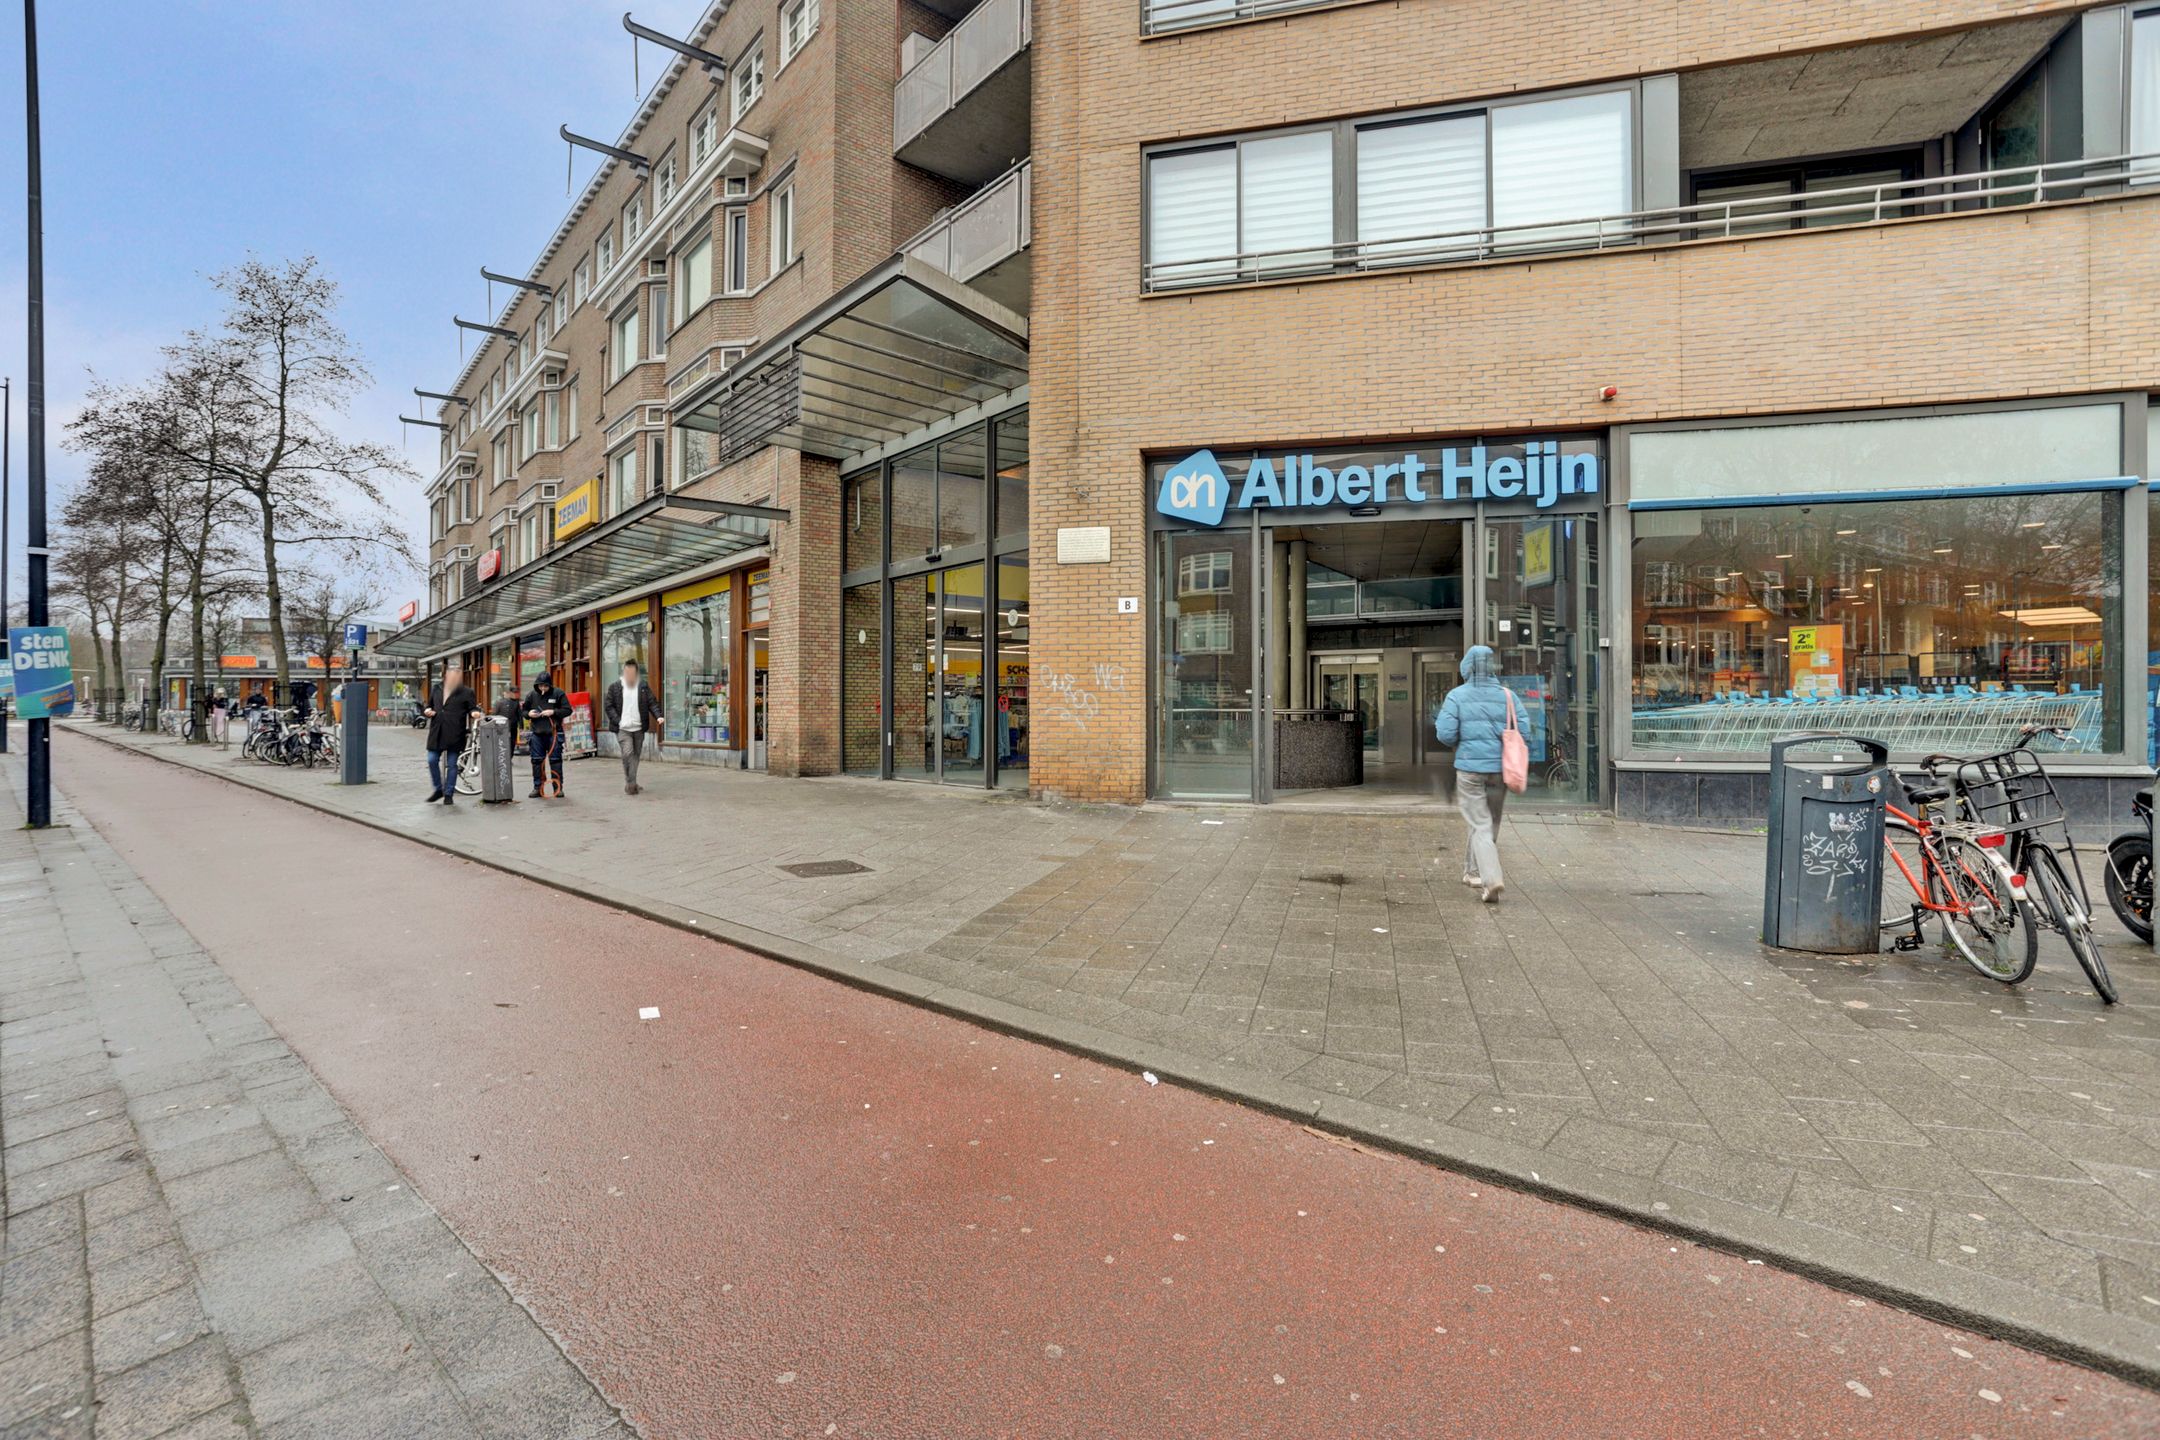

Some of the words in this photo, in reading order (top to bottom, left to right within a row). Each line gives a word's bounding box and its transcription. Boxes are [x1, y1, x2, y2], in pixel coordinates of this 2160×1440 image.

[1238, 454, 1426, 509] Albert
[1442, 440, 1598, 508] Heijn
[558, 494, 588, 529] ZEEMAN
[1124, 600, 1131, 610] B
[347, 625, 357, 638] P
[21, 633, 64, 650] stem
[13, 650, 70, 670] DENK
